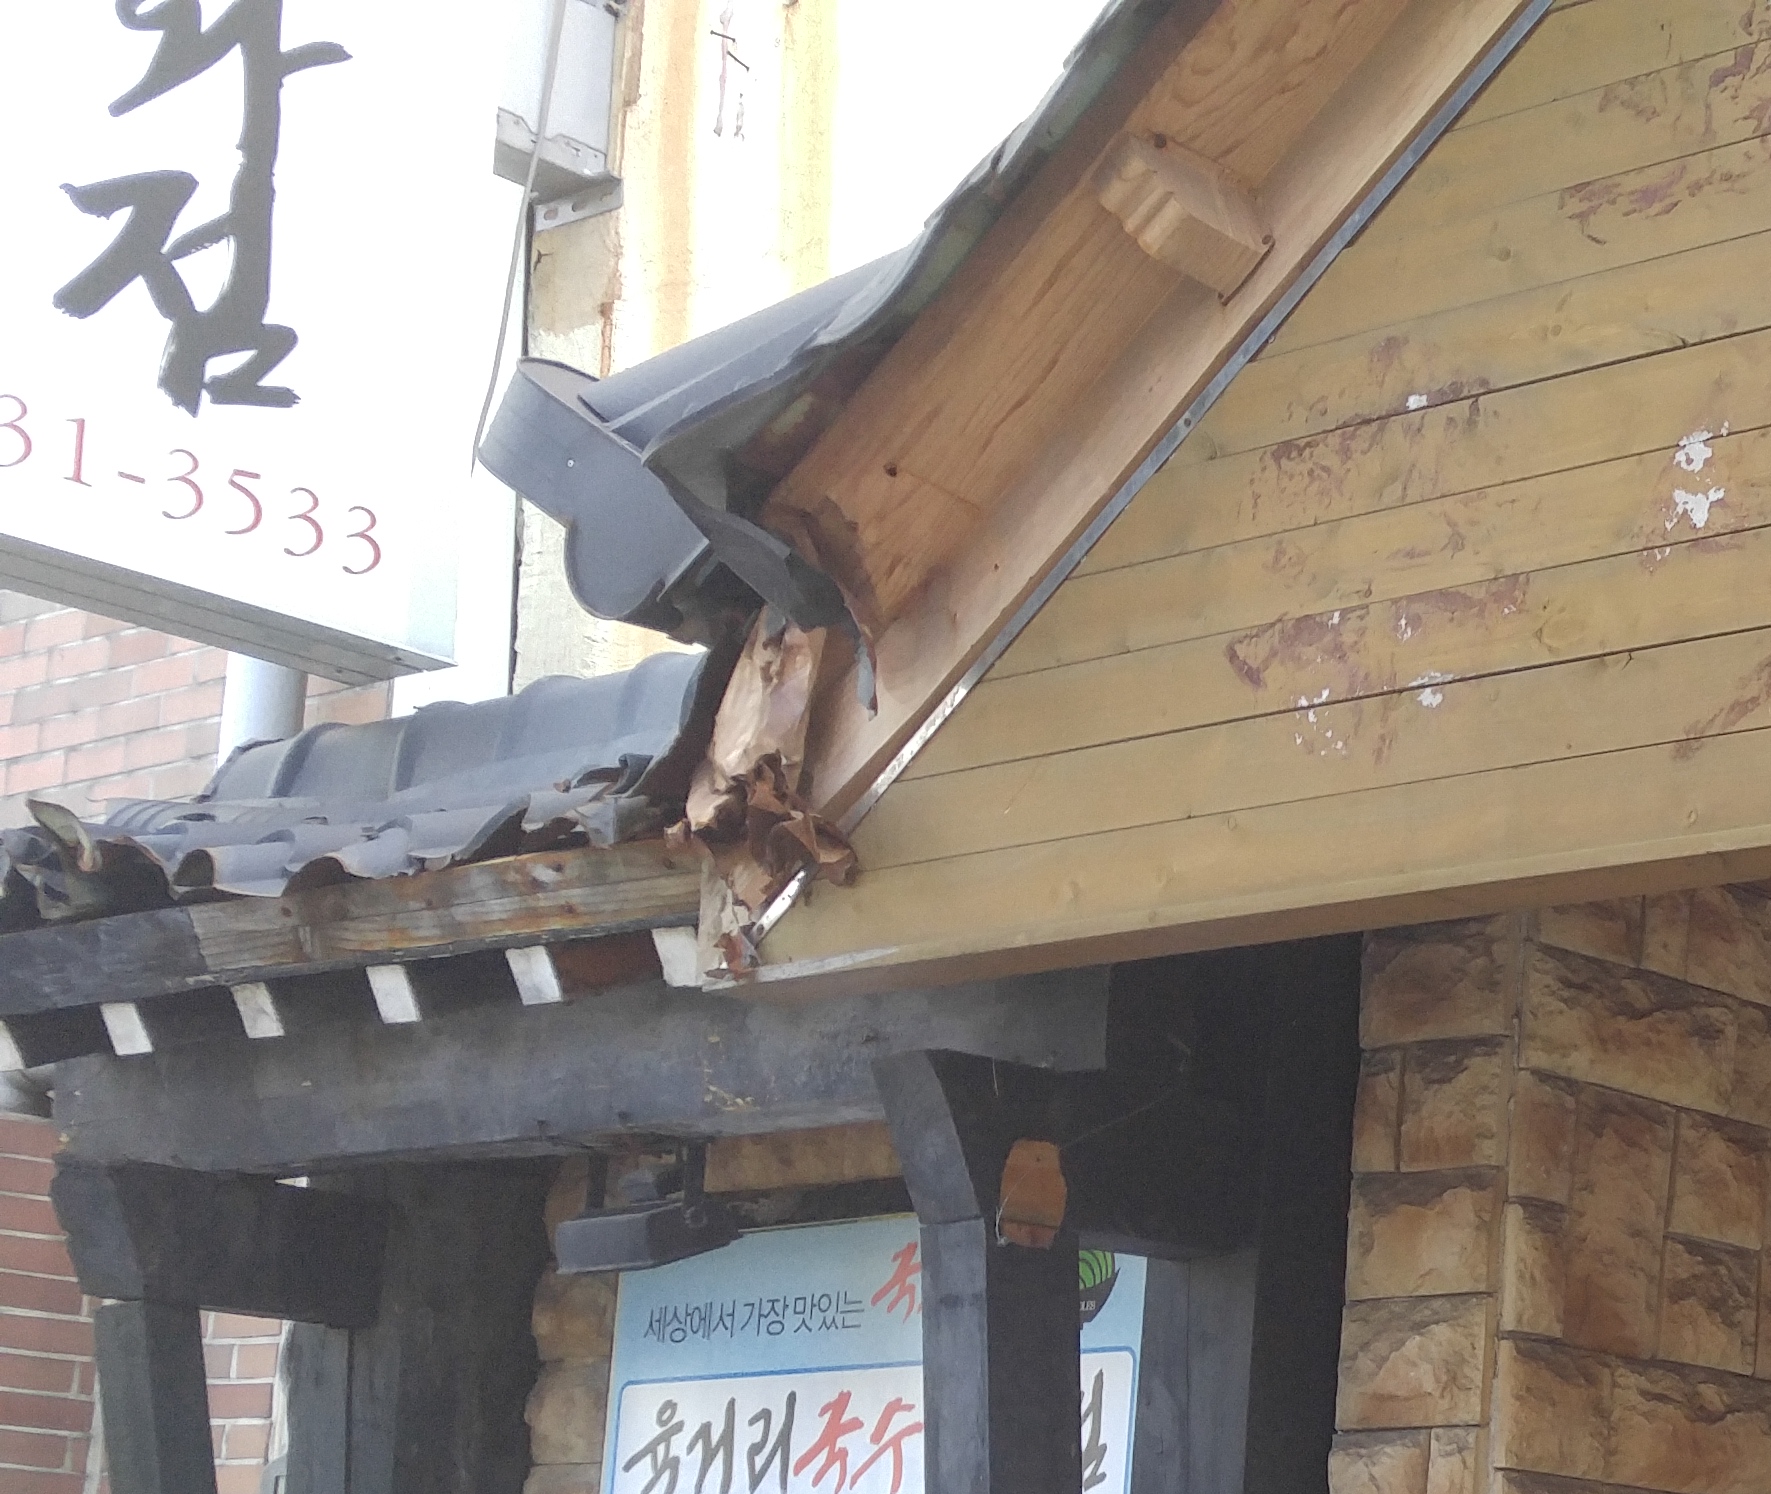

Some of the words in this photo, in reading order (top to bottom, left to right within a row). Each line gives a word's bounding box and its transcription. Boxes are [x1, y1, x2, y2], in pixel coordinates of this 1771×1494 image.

[644, 1300, 736, 1344] 세상에서
[740, 1295, 789, 1337] 가장
[793, 1290, 865, 1333] 맛있는
[870, 1241, 923, 1324] 국
